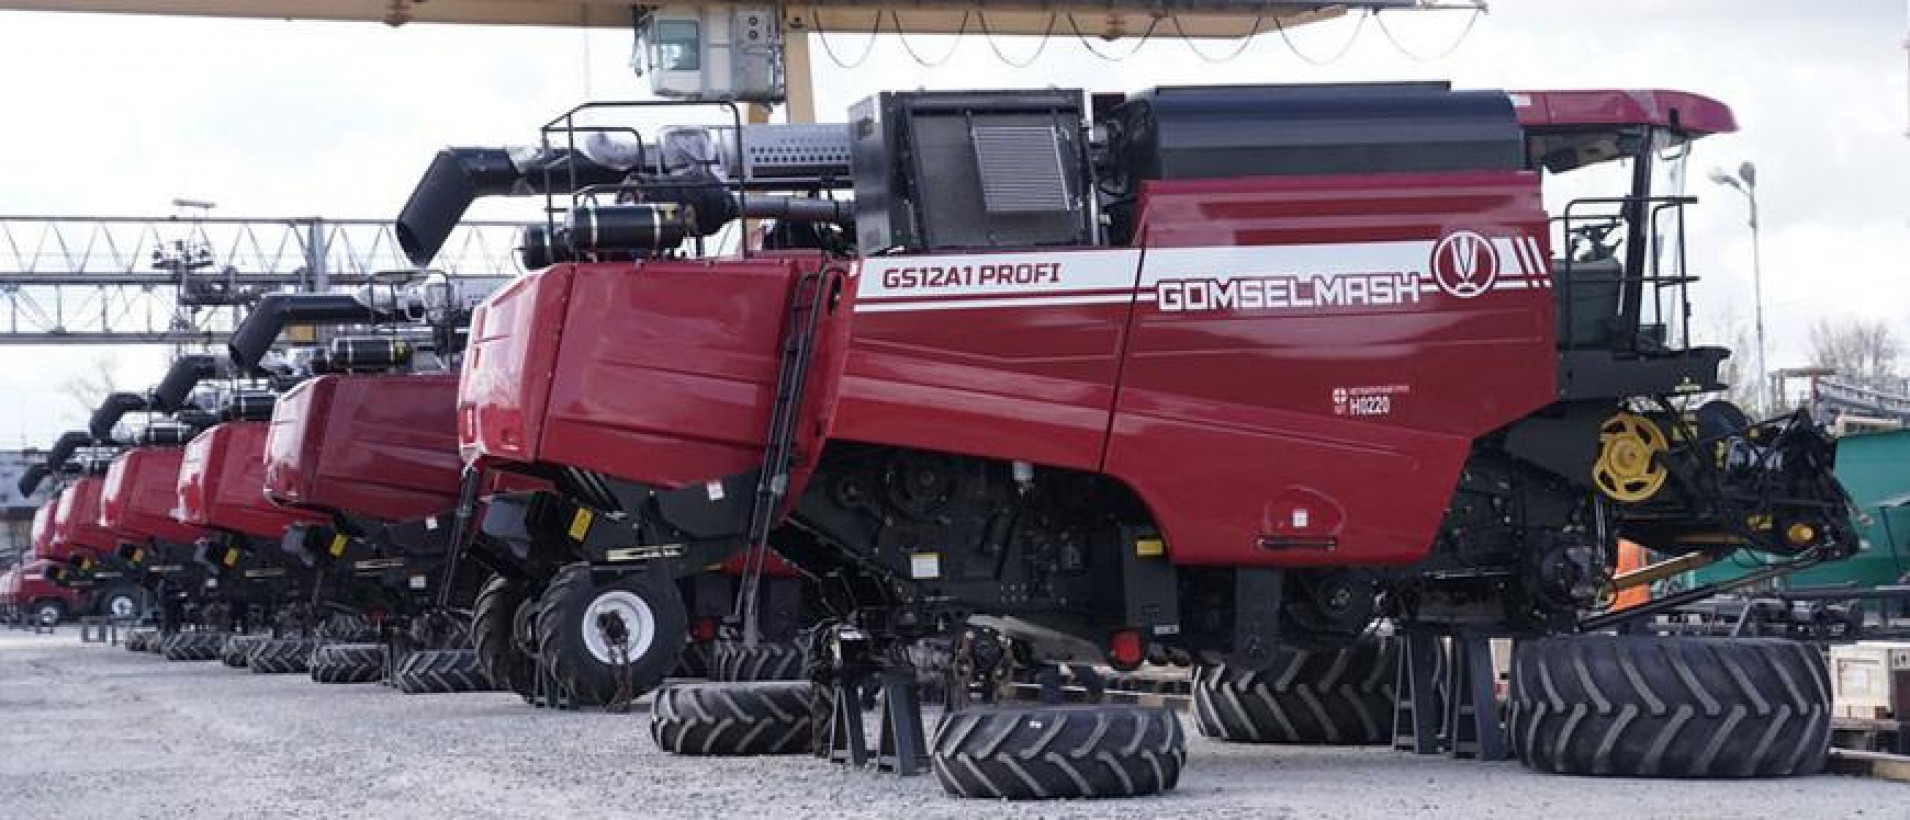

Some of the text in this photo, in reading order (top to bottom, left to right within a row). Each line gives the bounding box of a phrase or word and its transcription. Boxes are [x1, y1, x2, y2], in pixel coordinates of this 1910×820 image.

[883, 263, 1061, 289] GS12A1 PROFI
[1158, 274, 1419, 311] GOMSELMASH
